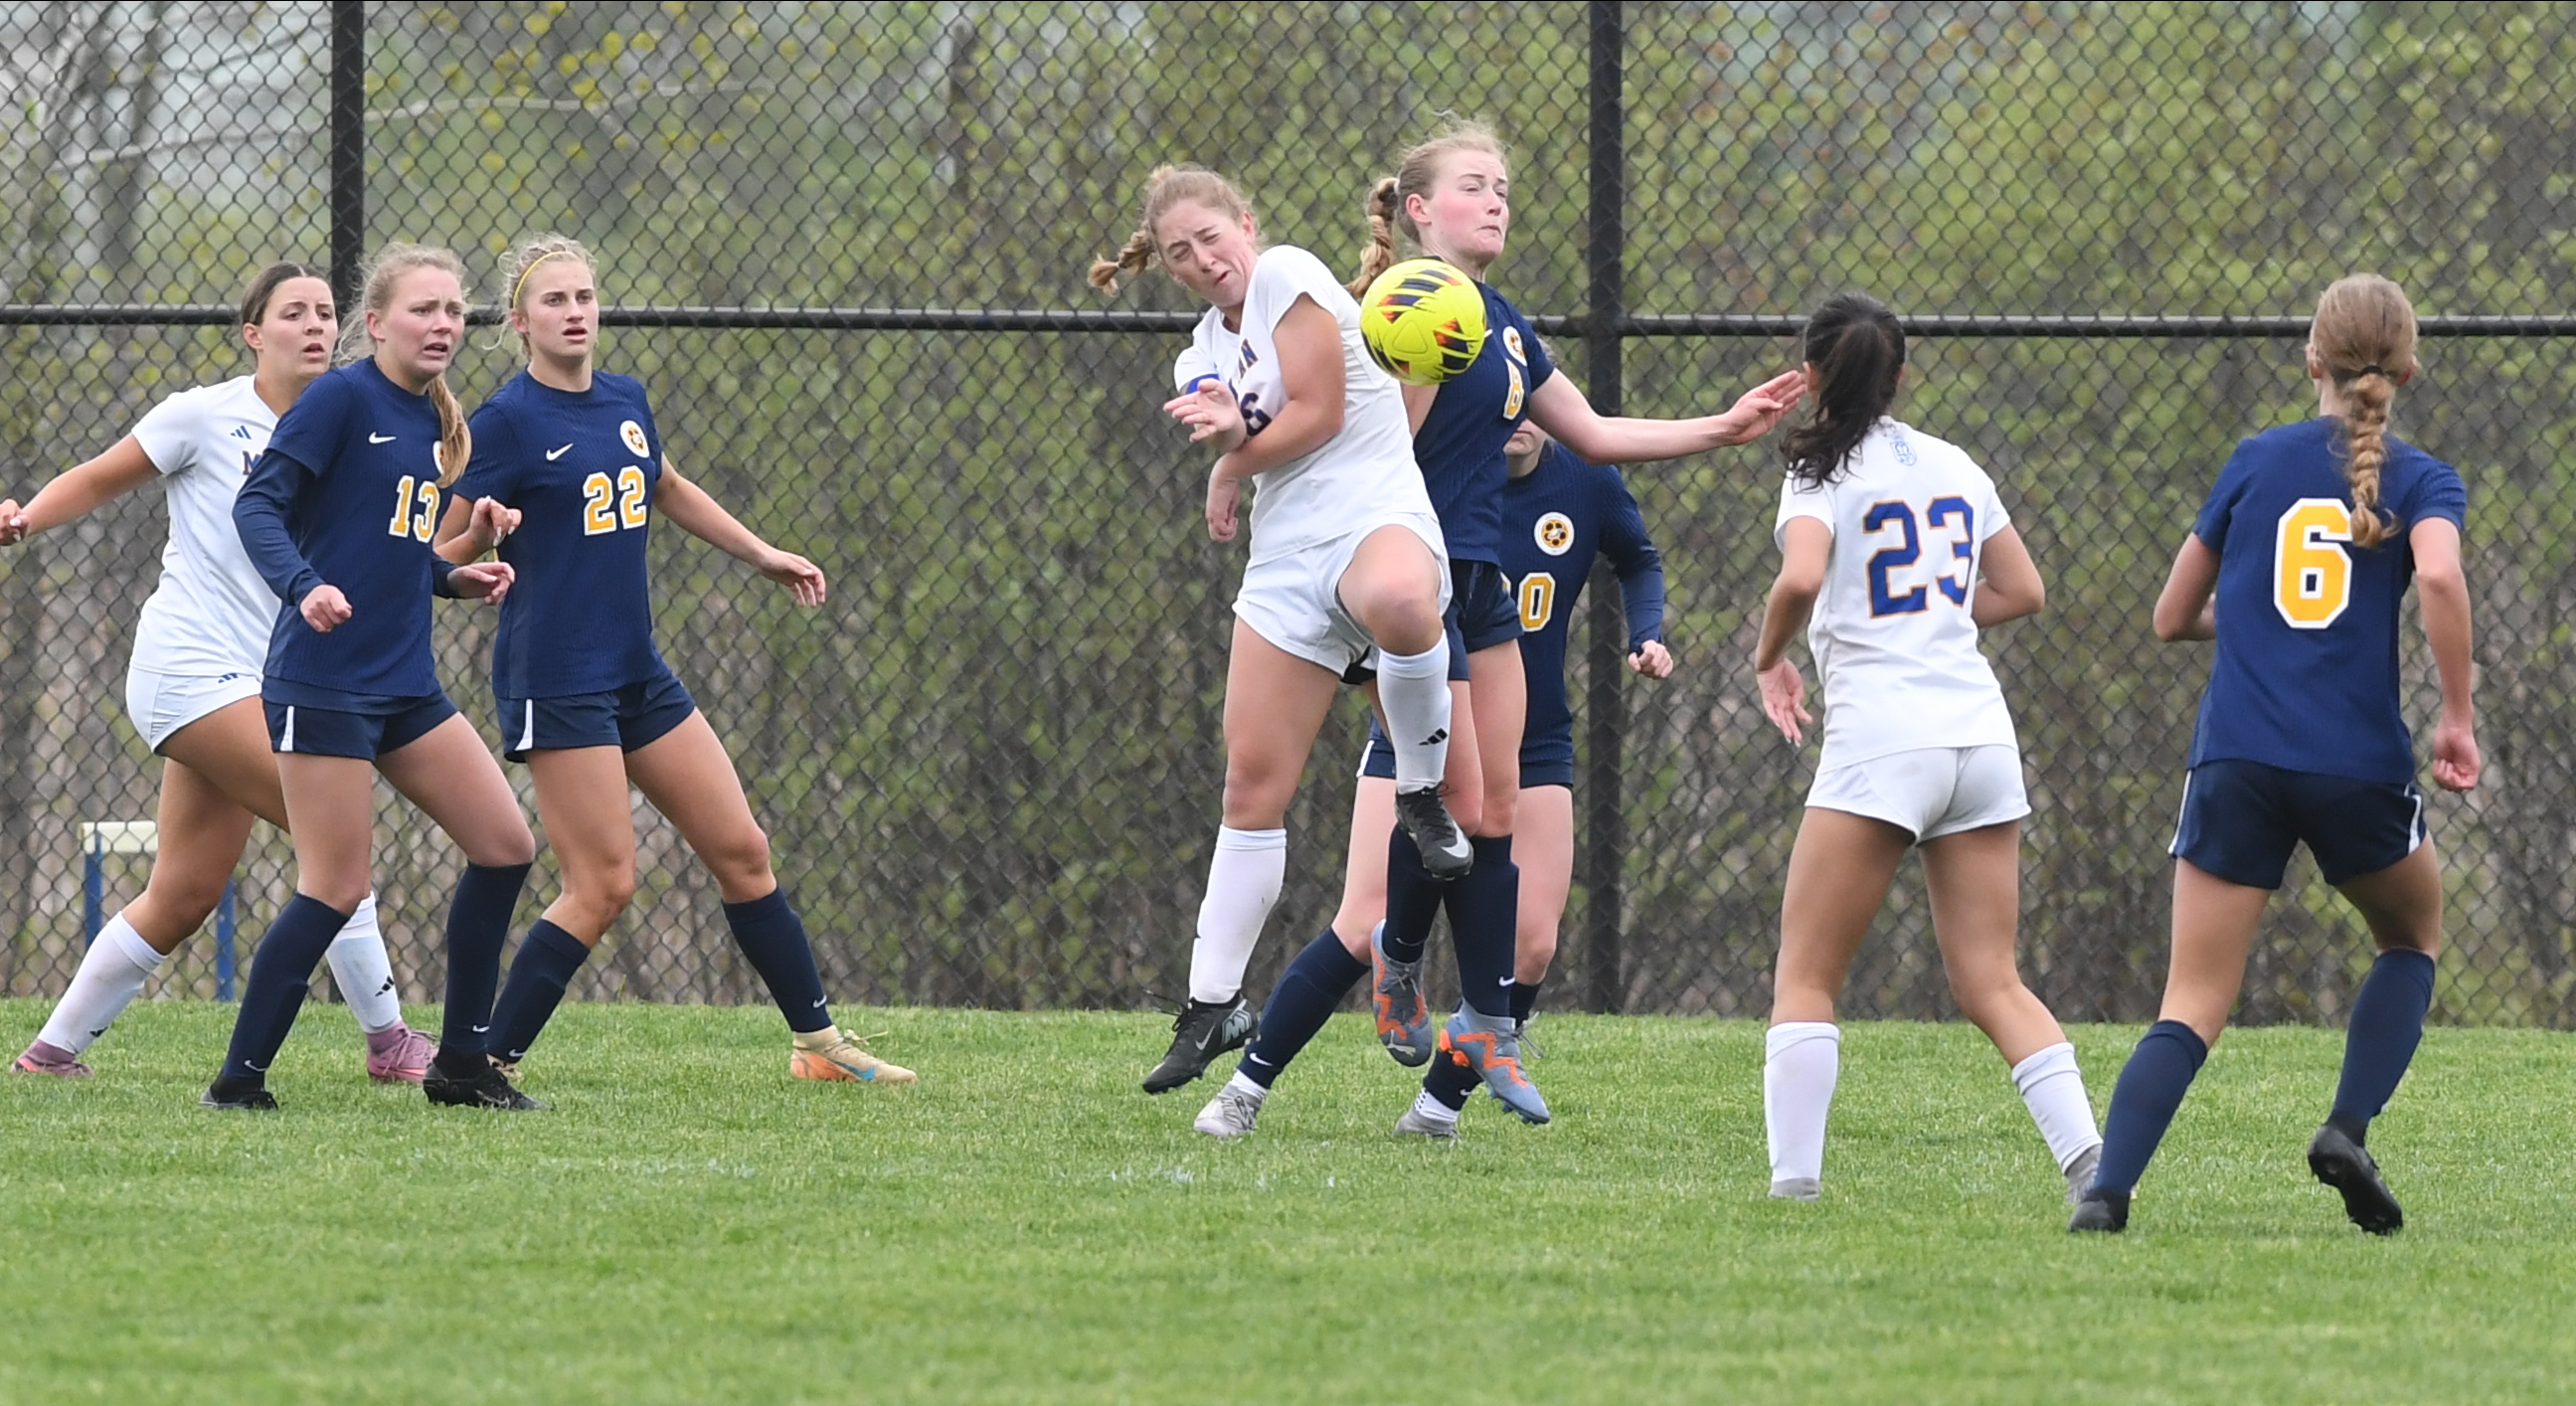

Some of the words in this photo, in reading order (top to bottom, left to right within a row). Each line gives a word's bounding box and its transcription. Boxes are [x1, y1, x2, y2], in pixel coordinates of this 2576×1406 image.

[1229, 377, 1273, 437] 6
[388, 474, 440, 543] 13
[583, 464, 646, 536] 22
[1862, 494, 1975, 619] 23
[2274, 497, 2353, 628] 6
[1499, 571, 1556, 632] 0
